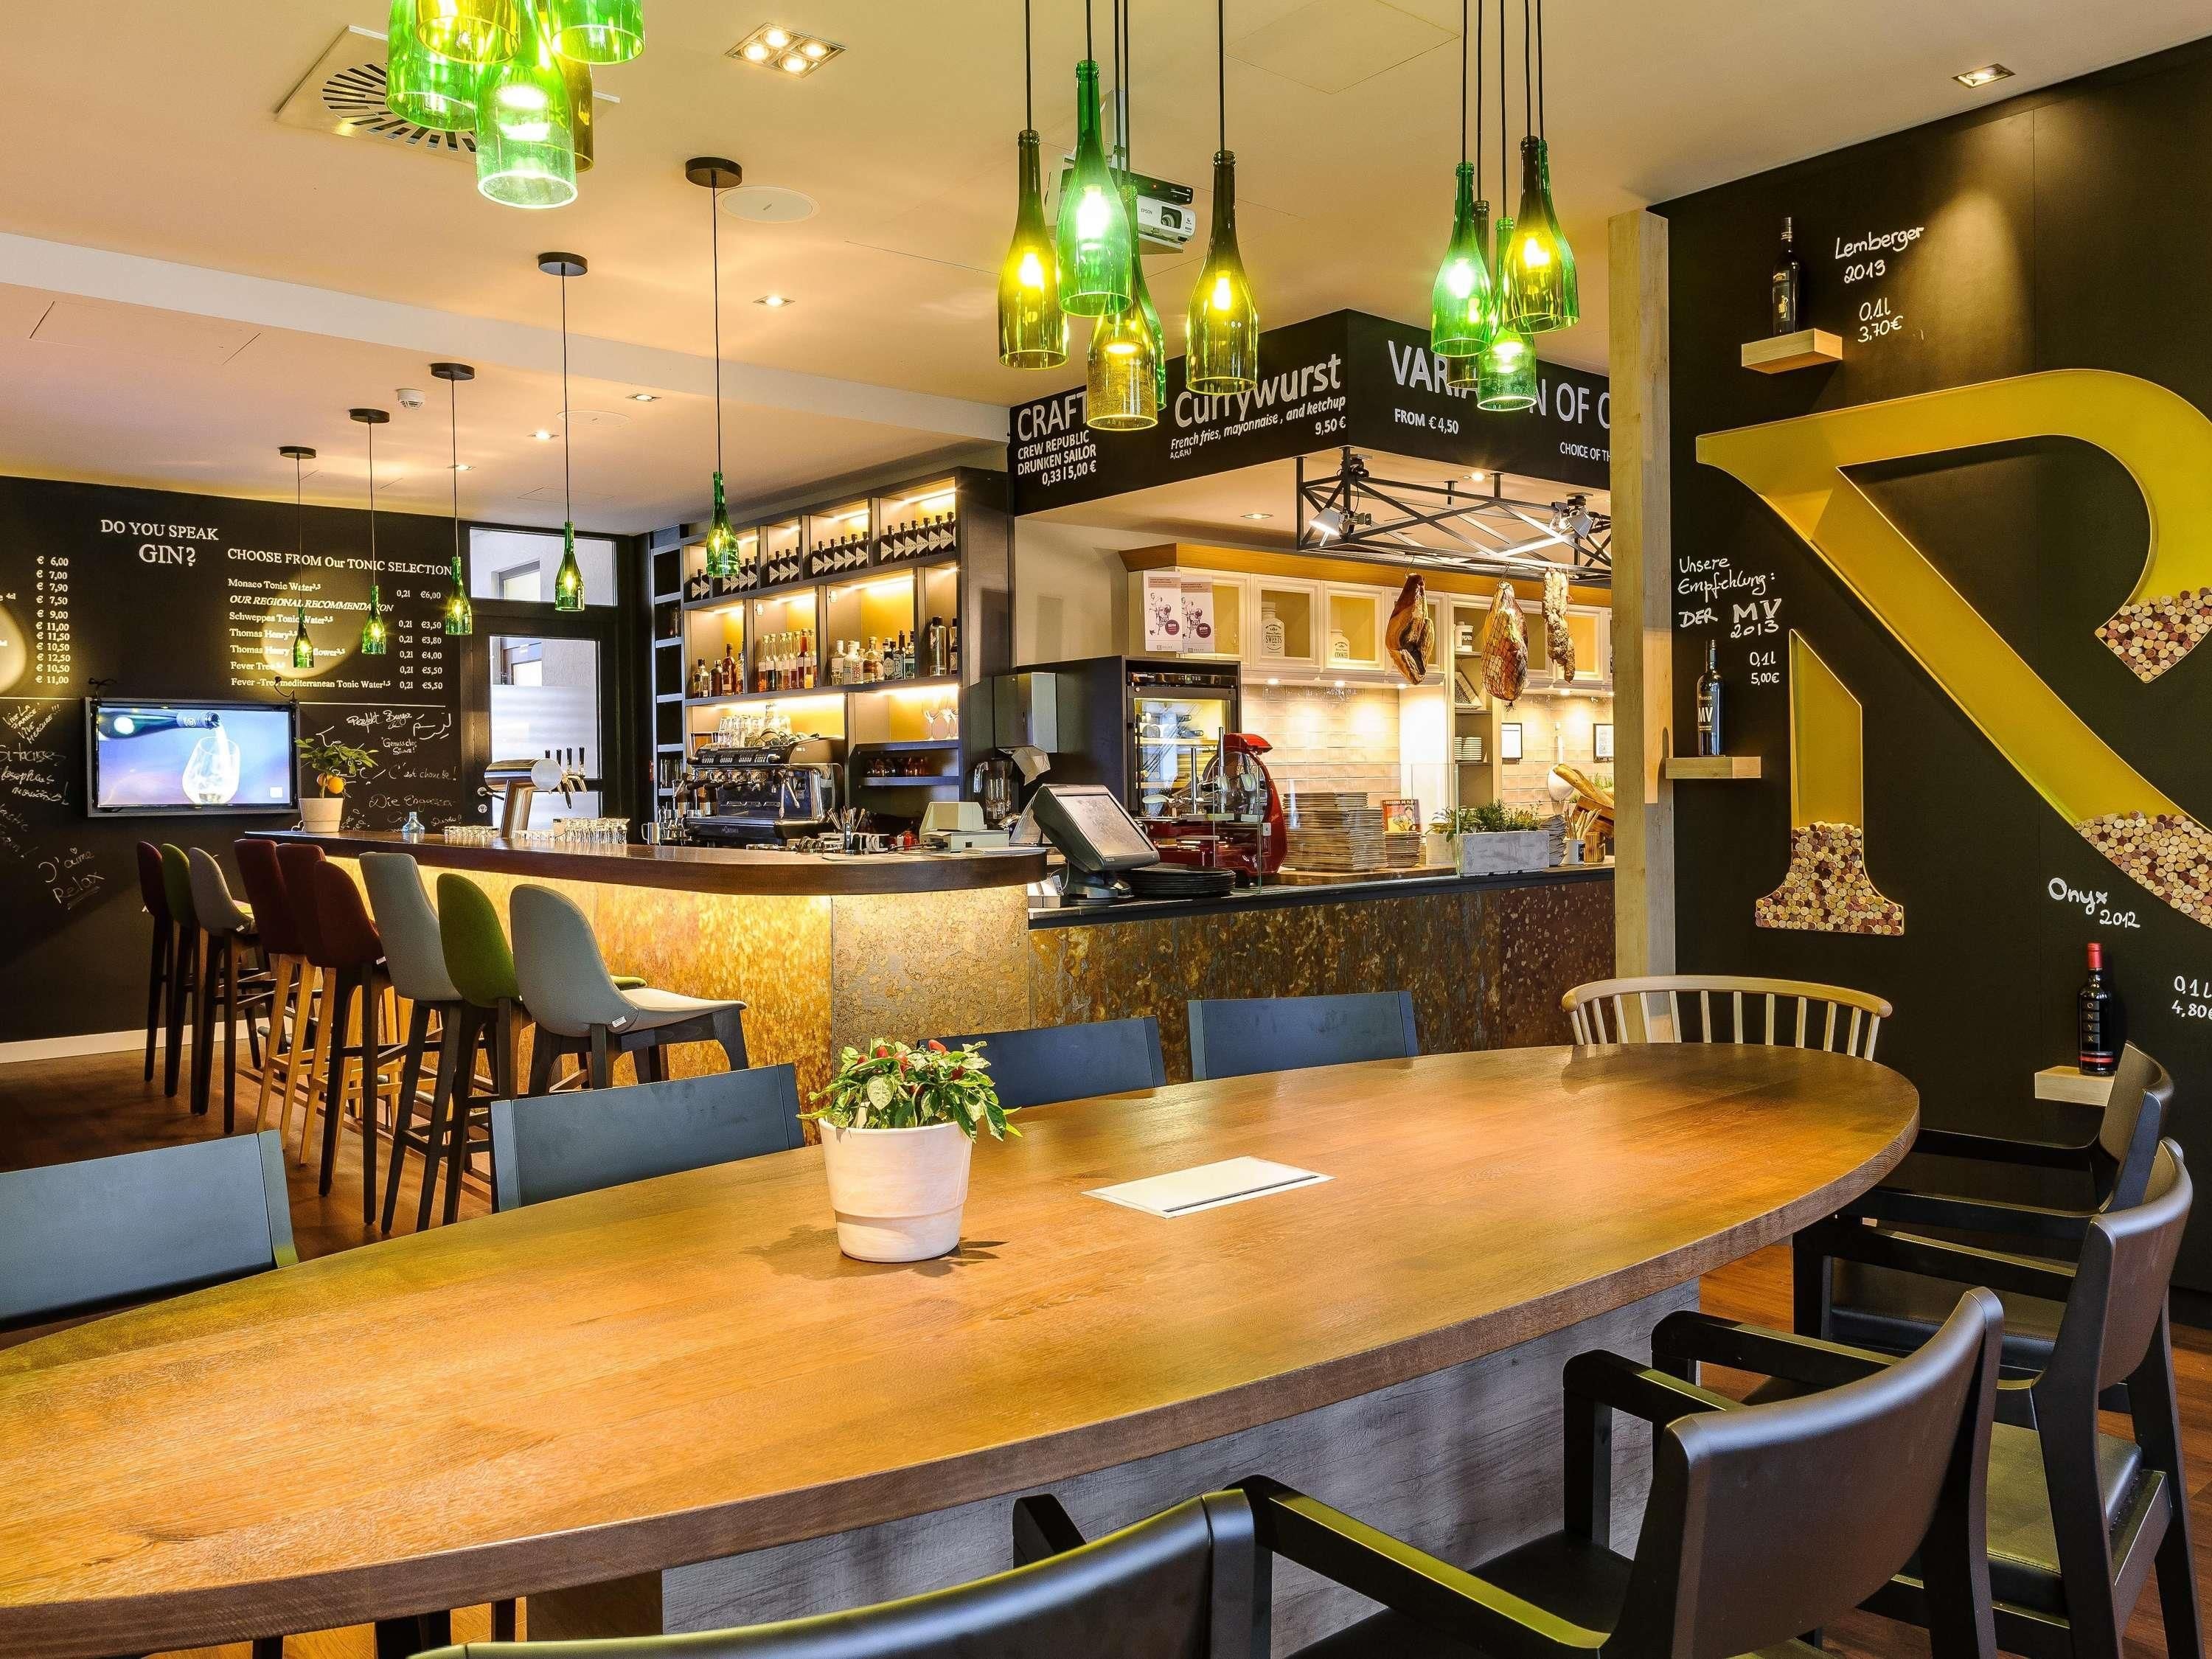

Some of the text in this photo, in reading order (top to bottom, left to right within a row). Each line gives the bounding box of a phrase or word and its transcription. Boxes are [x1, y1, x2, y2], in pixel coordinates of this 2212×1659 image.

[1835, 227, 1924, 259] Lemberger
[1844, 260, 1885, 284] 2013
[1857, 316, 1903, 343] 3,70€
[1175, 353, 1341, 428] Currywurst
[1557, 383, 1590, 423] OF
[1018, 392, 1087, 441] CRAFT
[1171, 431, 1199, 450] French
[1199, 428, 1221, 446] fries,
[1286, 404, 1305, 421] and
[1307, 395, 1346, 415] ketchup
[1315, 416, 1346, 436] 9,50 €
[1395, 408, 1459, 434] FROM € 4,50
[1018, 430, 1089, 459] CREW REPUBLIC
[1559, 442, 1588, 459] CHOICE
[1590, 448, 1601, 461] OF
[1018, 444, 1096, 476] DRUNKEN SAILOR
[1042, 469, 1061, 487] 0,33
[1068, 462, 1088, 480] 5,00
[1089, 460, 1096, 473] €
[101, 519, 219, 540] DO YOU SPEAK
[139, 544, 196, 566] GIN?
[227, 548, 452, 576] CHOOSE FROM Our TONIC SELECTION
[1679, 555, 1731, 574] Unsere
[228, 578, 262, 588] Monaco
[263, 580, 288, 590] Tonic
[1677, 569, 1775, 603] Empfehlung:
[229, 595, 252, 605] OUR
[252, 597, 304, 608] REGIONAL
[1678, 597, 1782, 627] DER MV
[229, 611, 276, 624] Schweppes
[276, 613, 299, 623] Tonic
[1731, 619, 1779, 639] 2013
[229, 628, 262, 638] Thomas
[230, 644, 262, 654] Thomas
[230, 661, 255, 669] Fever
[231, 678, 255, 686] Fever
[279, 678, 335, 688] mediterranean
[336, 680, 359, 688] Tonic
[1750, 672, 1780, 686] 5,00€
[1698, 706, 1713, 723] MV
[2048, 877, 2108, 915] Onyx
[2099, 909, 2140, 928] 2012
[2086, 1001, 2095, 1043] ONYX
